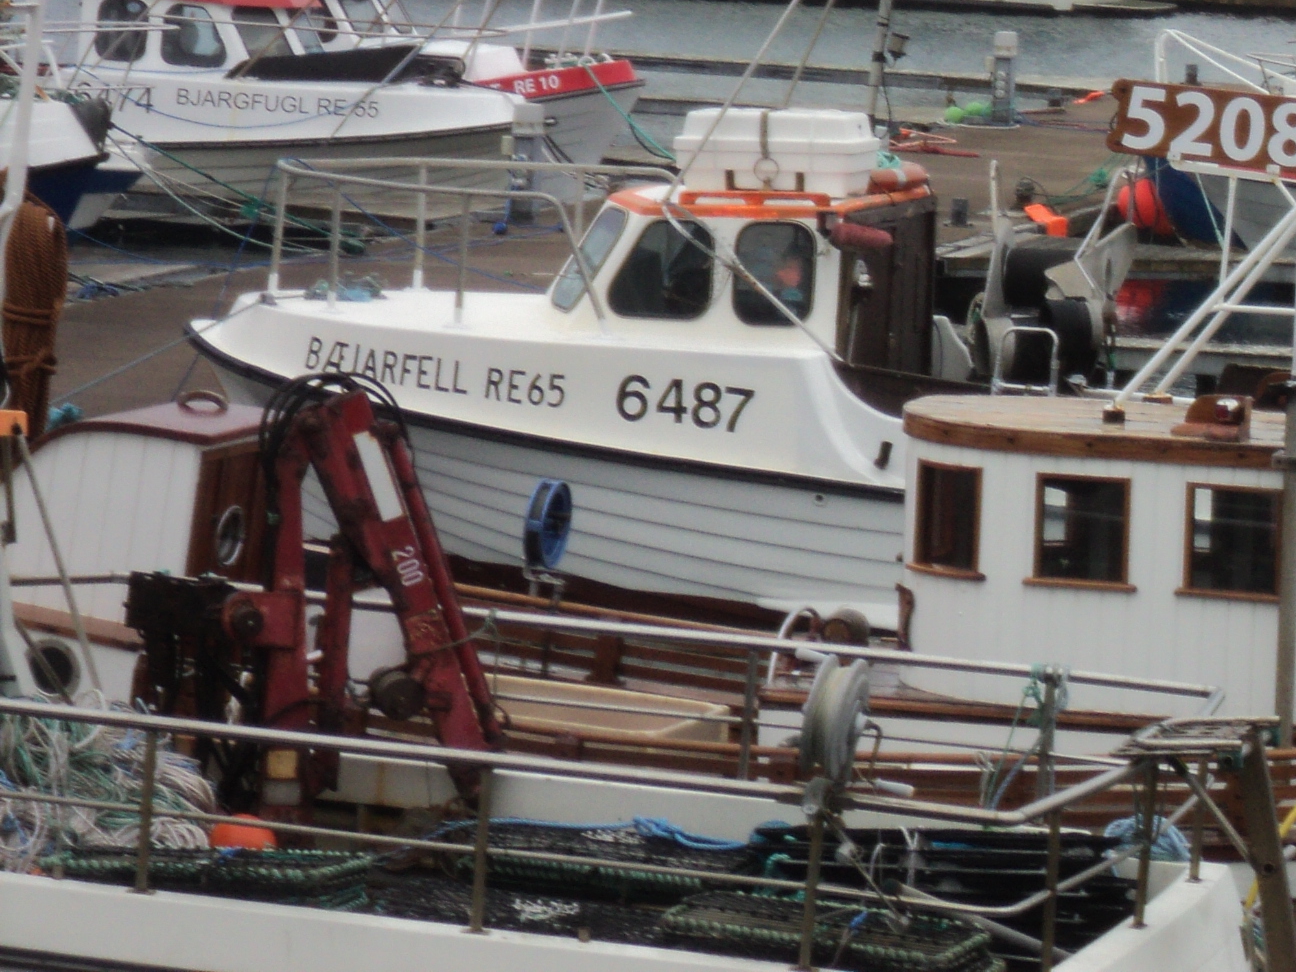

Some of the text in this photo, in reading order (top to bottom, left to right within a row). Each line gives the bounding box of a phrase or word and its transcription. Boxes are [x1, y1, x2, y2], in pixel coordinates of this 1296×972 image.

[176, 88, 309, 115] BJARGFUGL
[317, 97, 347, 117] RE
[513, 75, 560, 94] RE 10
[305, 336, 567, 409] BÆJARFELL RE65
[614, 374, 756, 433] 6487
[391, 545, 425, 587] 200
